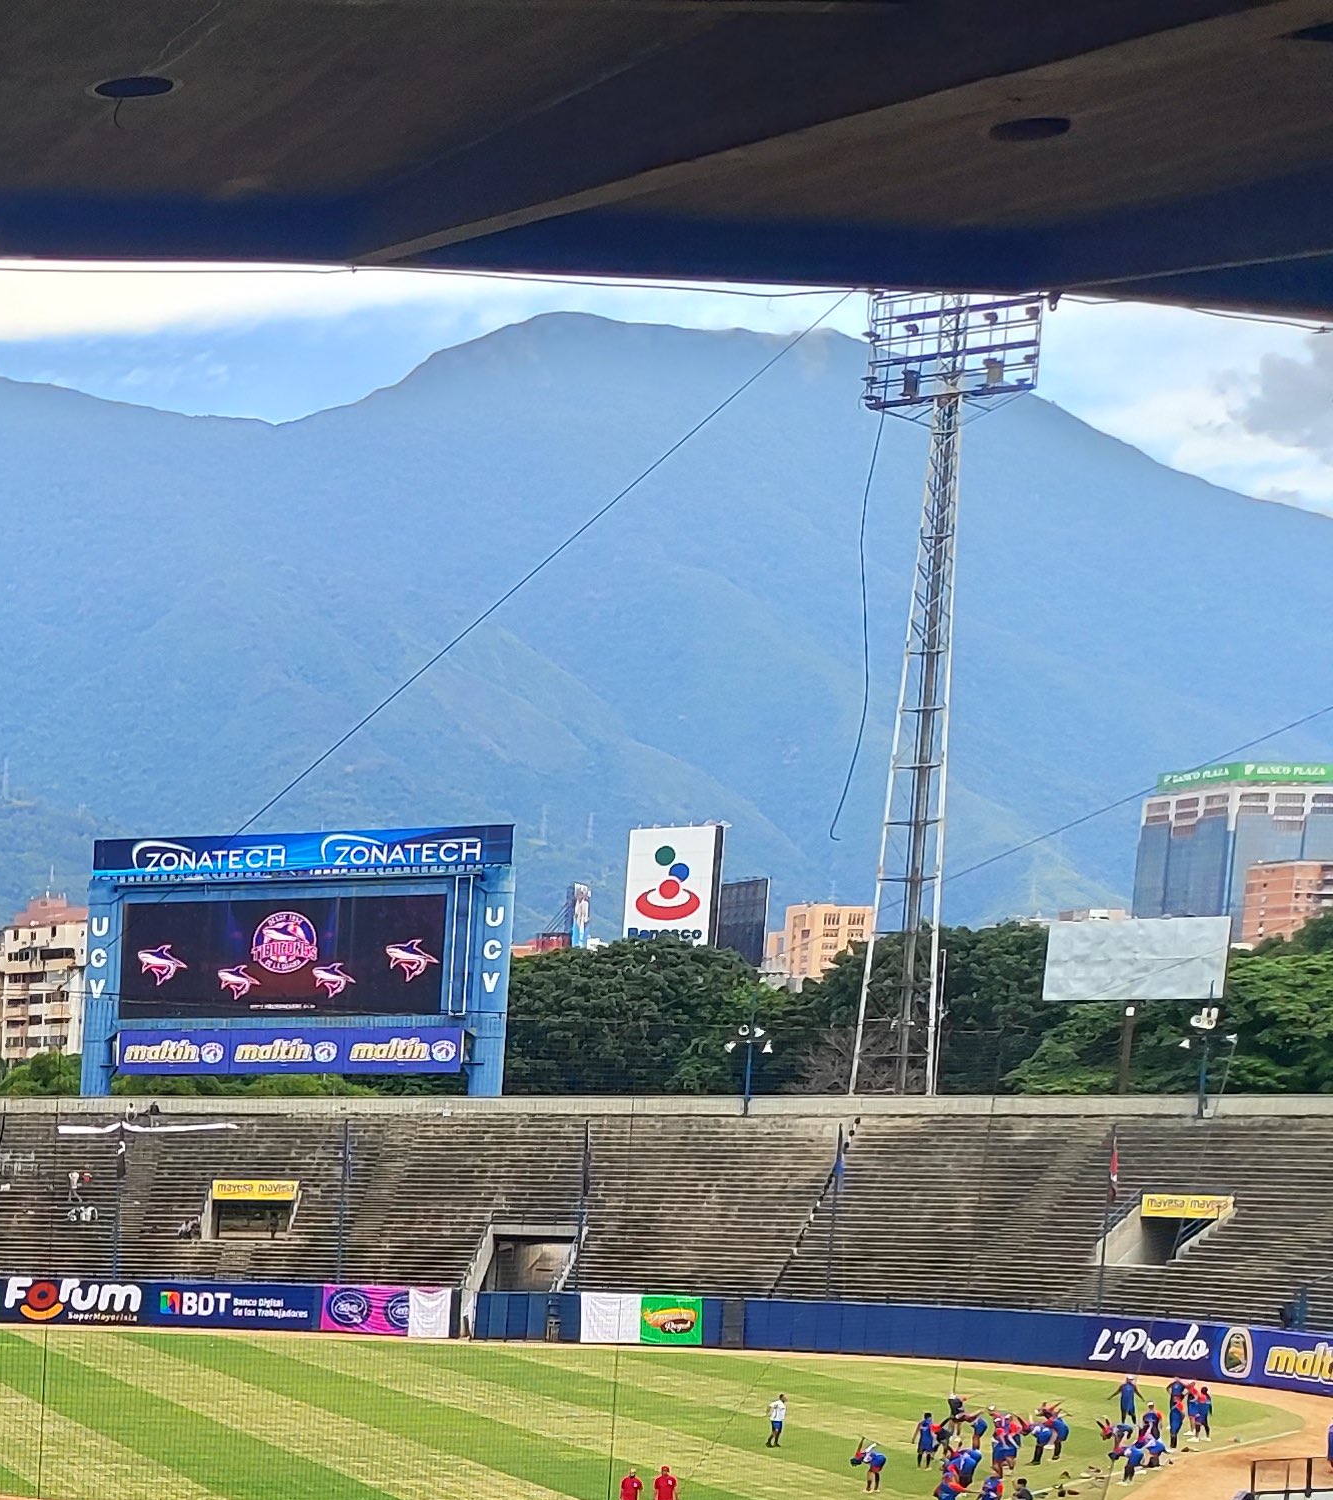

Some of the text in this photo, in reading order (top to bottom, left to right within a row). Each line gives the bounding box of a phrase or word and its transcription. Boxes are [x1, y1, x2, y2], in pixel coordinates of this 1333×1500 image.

[145, 847, 286, 871] ZONATECH
[334, 838, 483, 865] ZONATECH
[5, 1277, 142, 1310] Forum
[182, 1292, 231, 1317] BDT
[233, 1297, 284, 1309] Banco Digital
[1088, 1324, 1209, 1361] L'Prado
